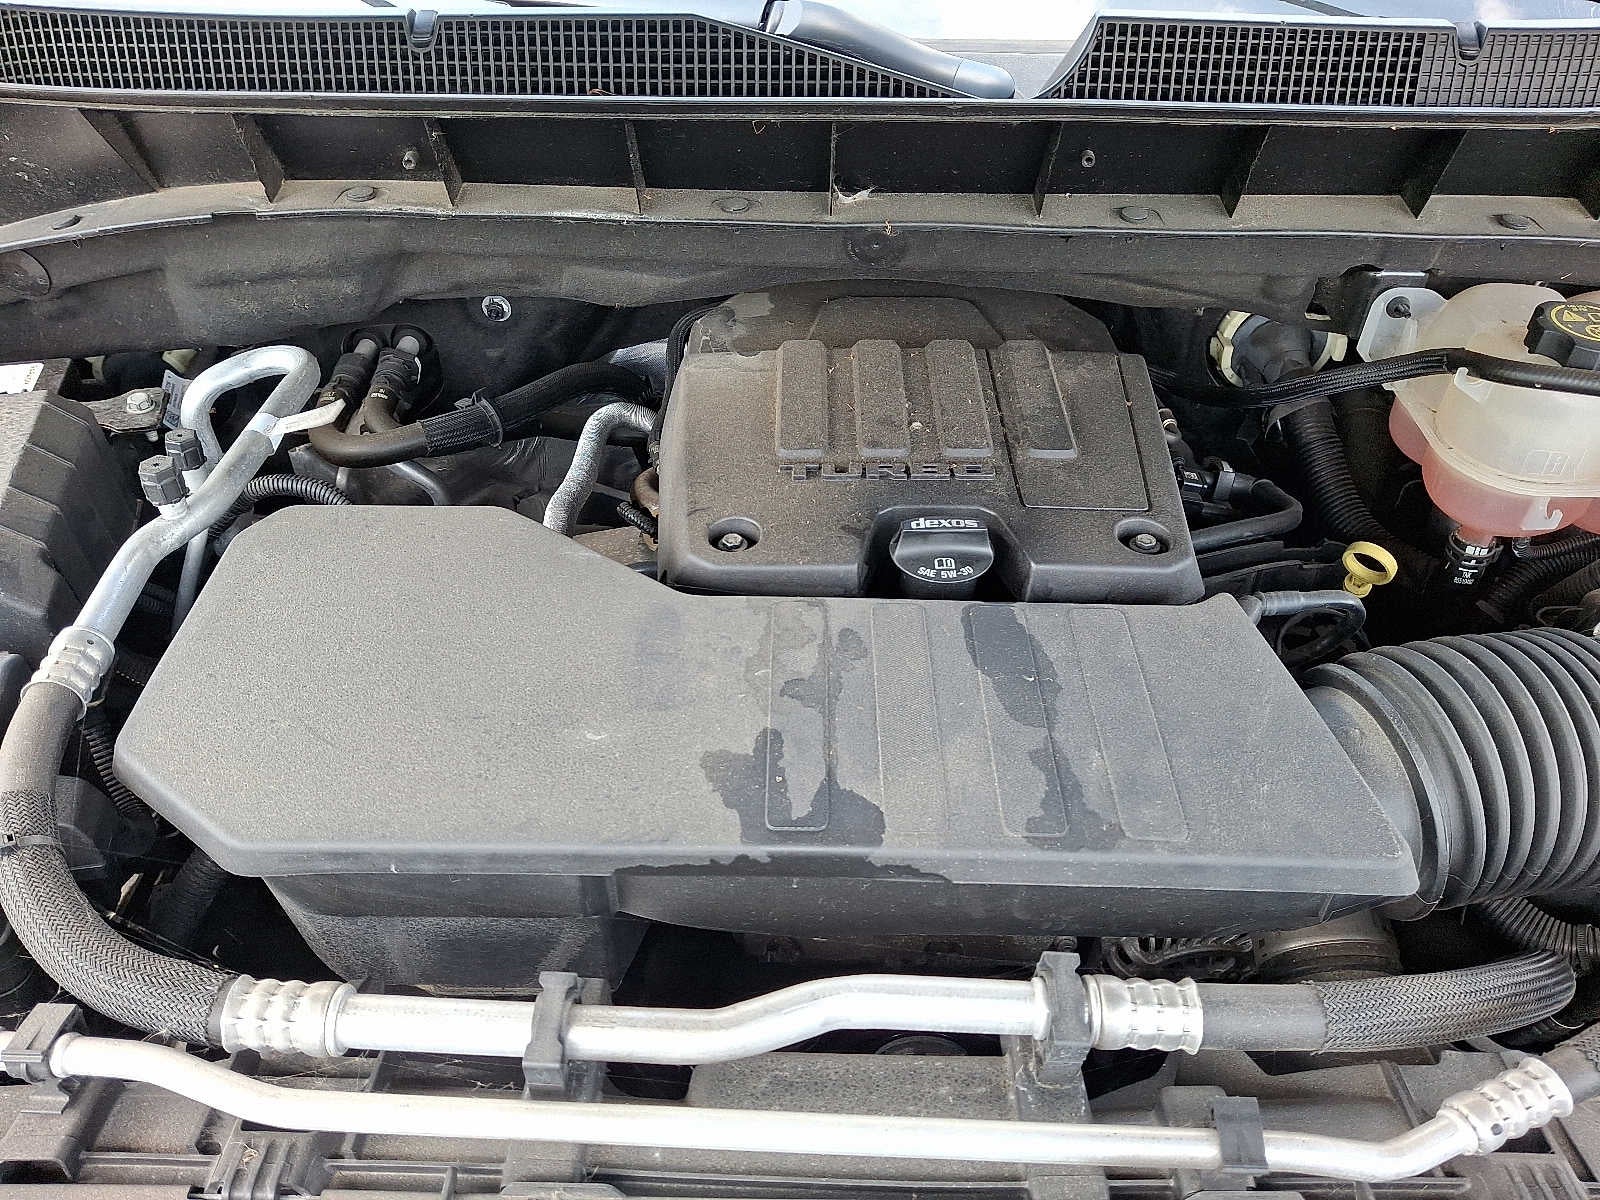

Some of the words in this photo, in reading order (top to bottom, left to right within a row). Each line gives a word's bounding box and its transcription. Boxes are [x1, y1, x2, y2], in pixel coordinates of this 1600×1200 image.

[911, 517, 979, 529] dexos
[917, 566, 938, 578] SAE
[940, 565, 974, 579] 5W-30
